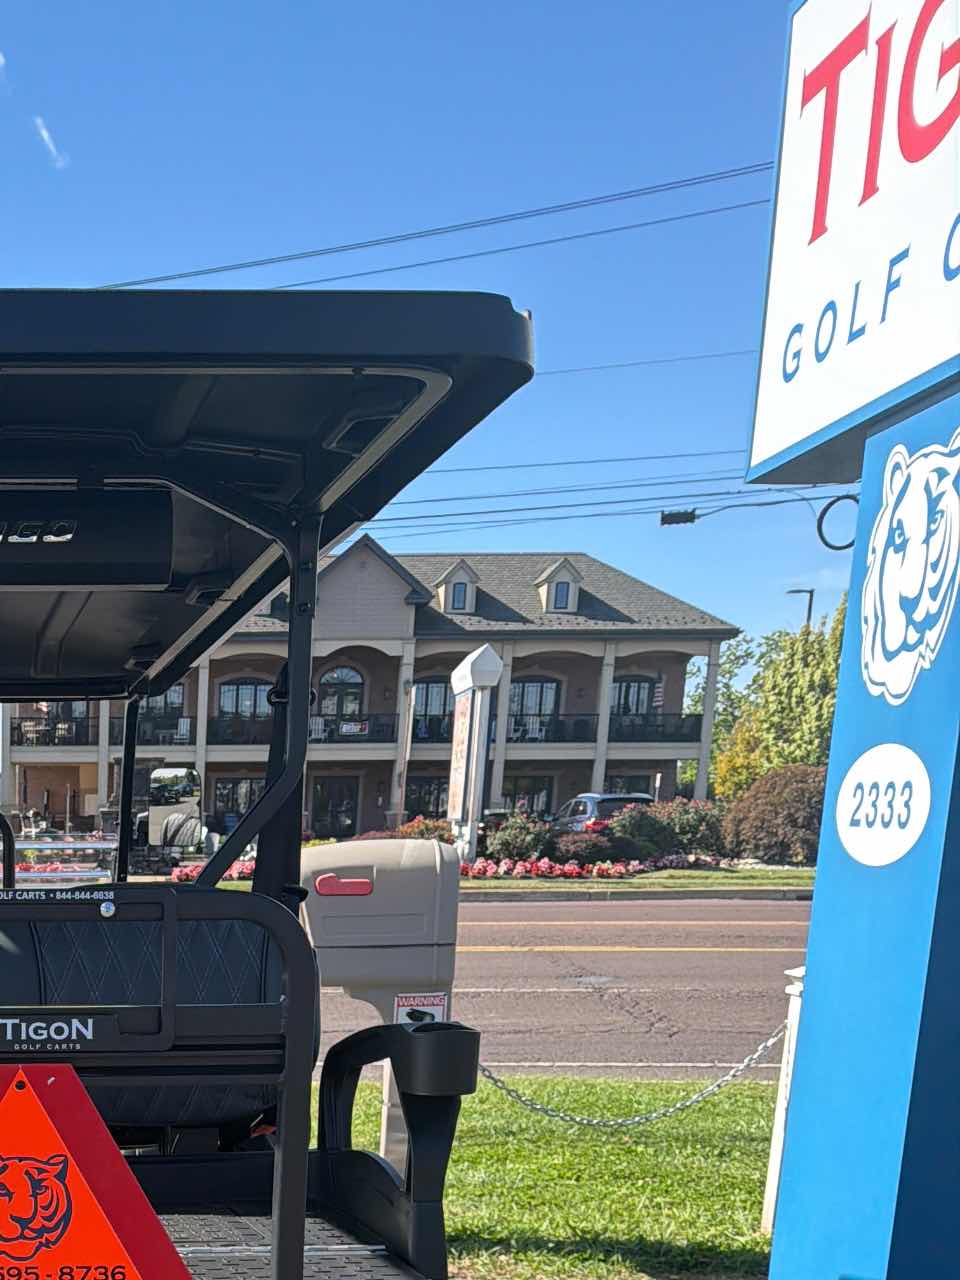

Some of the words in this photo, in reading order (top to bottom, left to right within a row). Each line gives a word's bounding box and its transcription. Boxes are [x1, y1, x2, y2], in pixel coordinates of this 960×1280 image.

[782, 241, 911, 384] GOLF
[848, 780, 913, 830] 2333
[15, 890, 46, 900] CARTS
[398, 995, 446, 1007] WARNING
